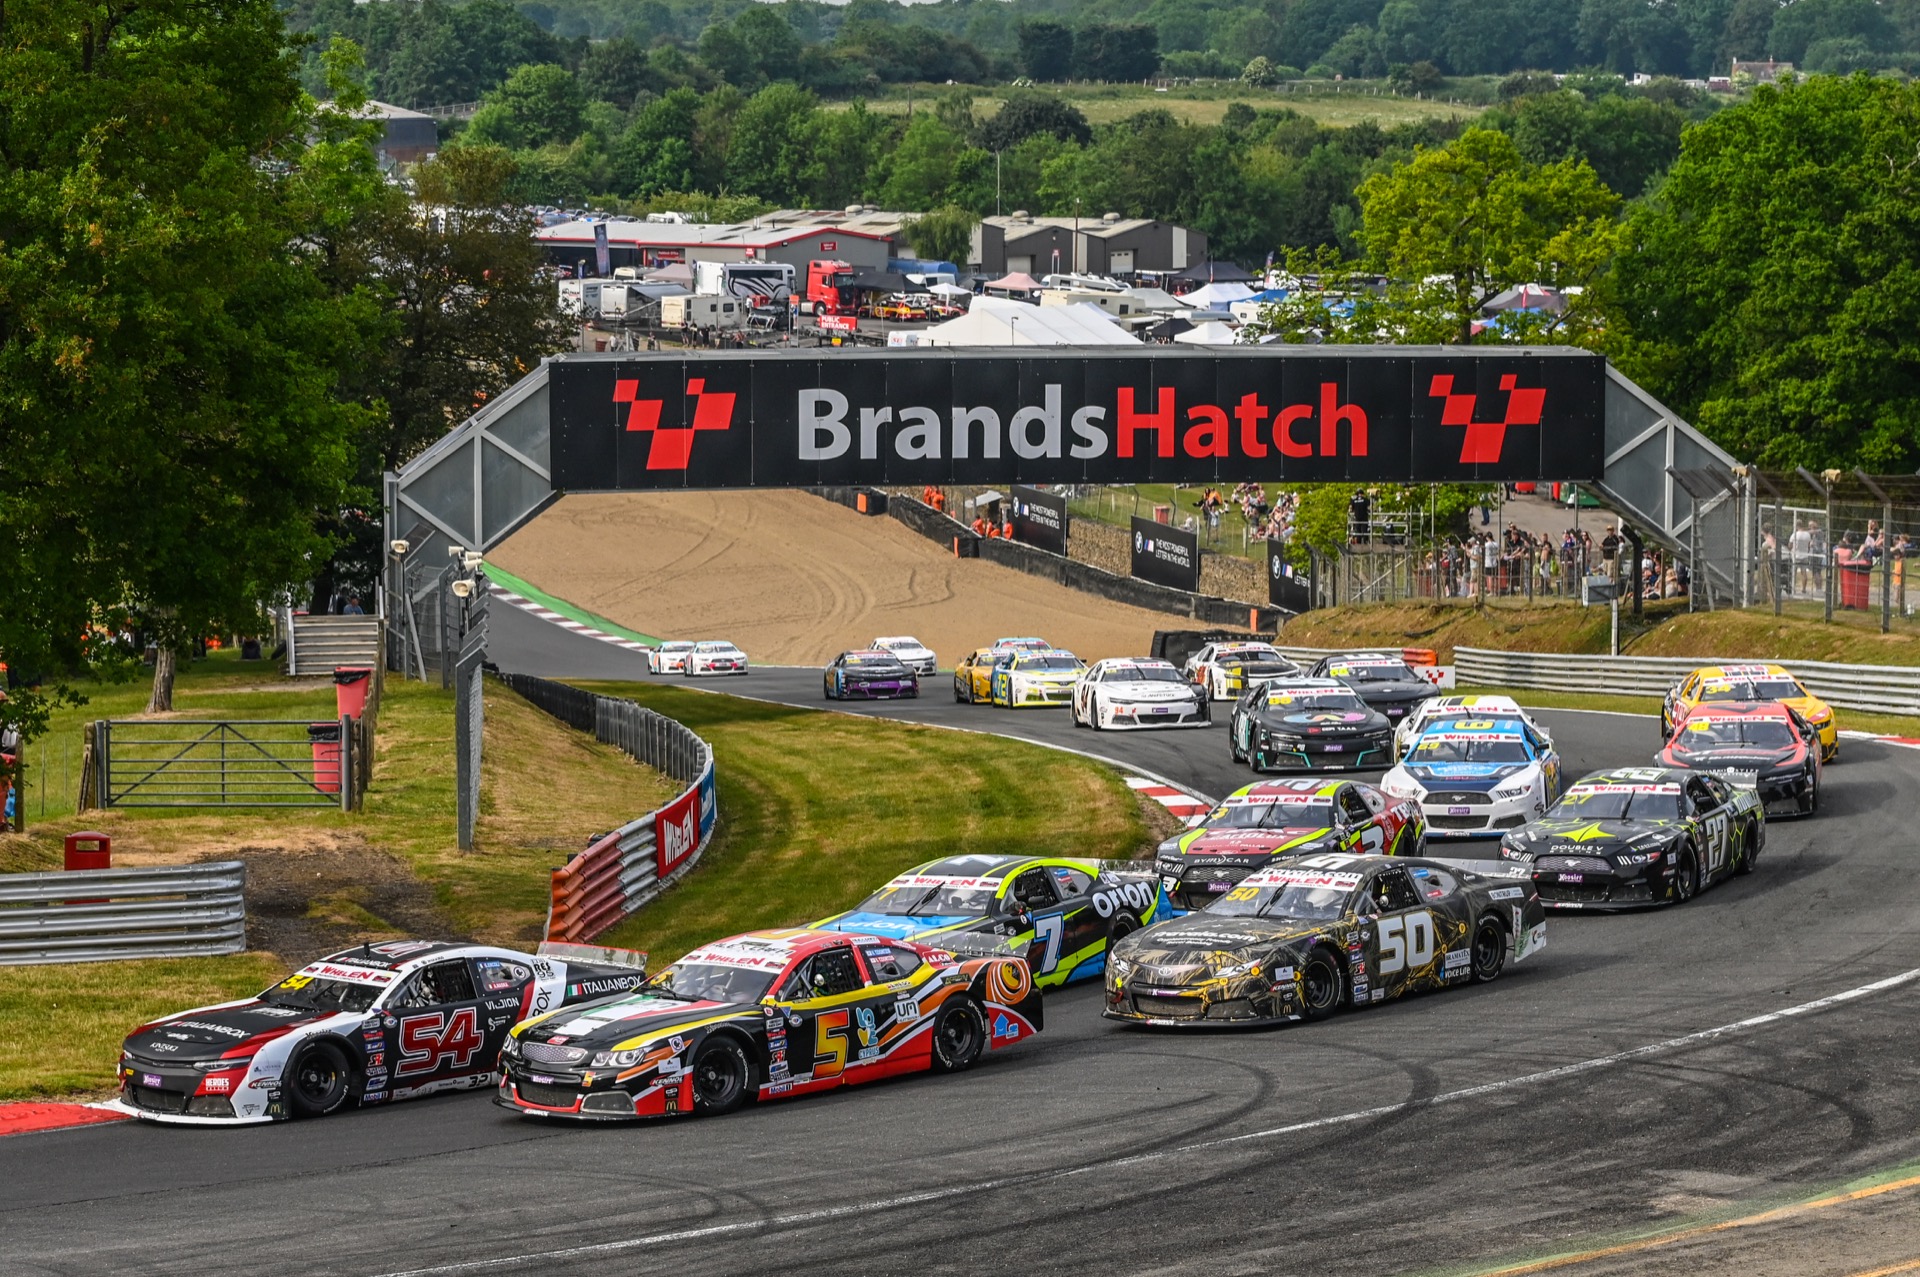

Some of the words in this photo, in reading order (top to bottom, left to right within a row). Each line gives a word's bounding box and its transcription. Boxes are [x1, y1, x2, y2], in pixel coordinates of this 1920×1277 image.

[821, 315, 840, 323] PUBLIC
[821, 322, 849, 330] ENTRANCE
[798, 382, 1368, 463] BrandsHatch
[1594, 784, 1657, 792] WHELEN
[1248, 796, 1308, 804] WHELEN
[1211, 807, 1229, 820] 3
[1704, 812, 1728, 872] 27
[914, 876, 977, 888] WHELEN
[1268, 874, 1334, 885] WHELEN
[1558, 873, 1582, 882] Hoosier
[879, 887, 899, 900] 7
[1208, 882, 1232, 892] Hoosier
[1092, 881, 1154, 918] orion
[1226, 888, 1260, 901] 50
[1034, 912, 1065, 975] 7
[1377, 911, 1434, 976] 50
[704, 953, 766, 966] WHELEN
[928, 952, 951, 964] ALCO
[320, 965, 375, 980] WHELEN
[280, 974, 315, 990] 54
[582, 976, 642, 995] ITALIANBOX
[394, 1006, 484, 1079] 54
[812, 1007, 850, 1080] 5
[858, 1046, 880, 1059] CYPRUS
[205, 1078, 230, 1086] HEROES
[652, 1076, 683, 1086] KENNOL
[770, 1086, 786, 1094] Mobil
